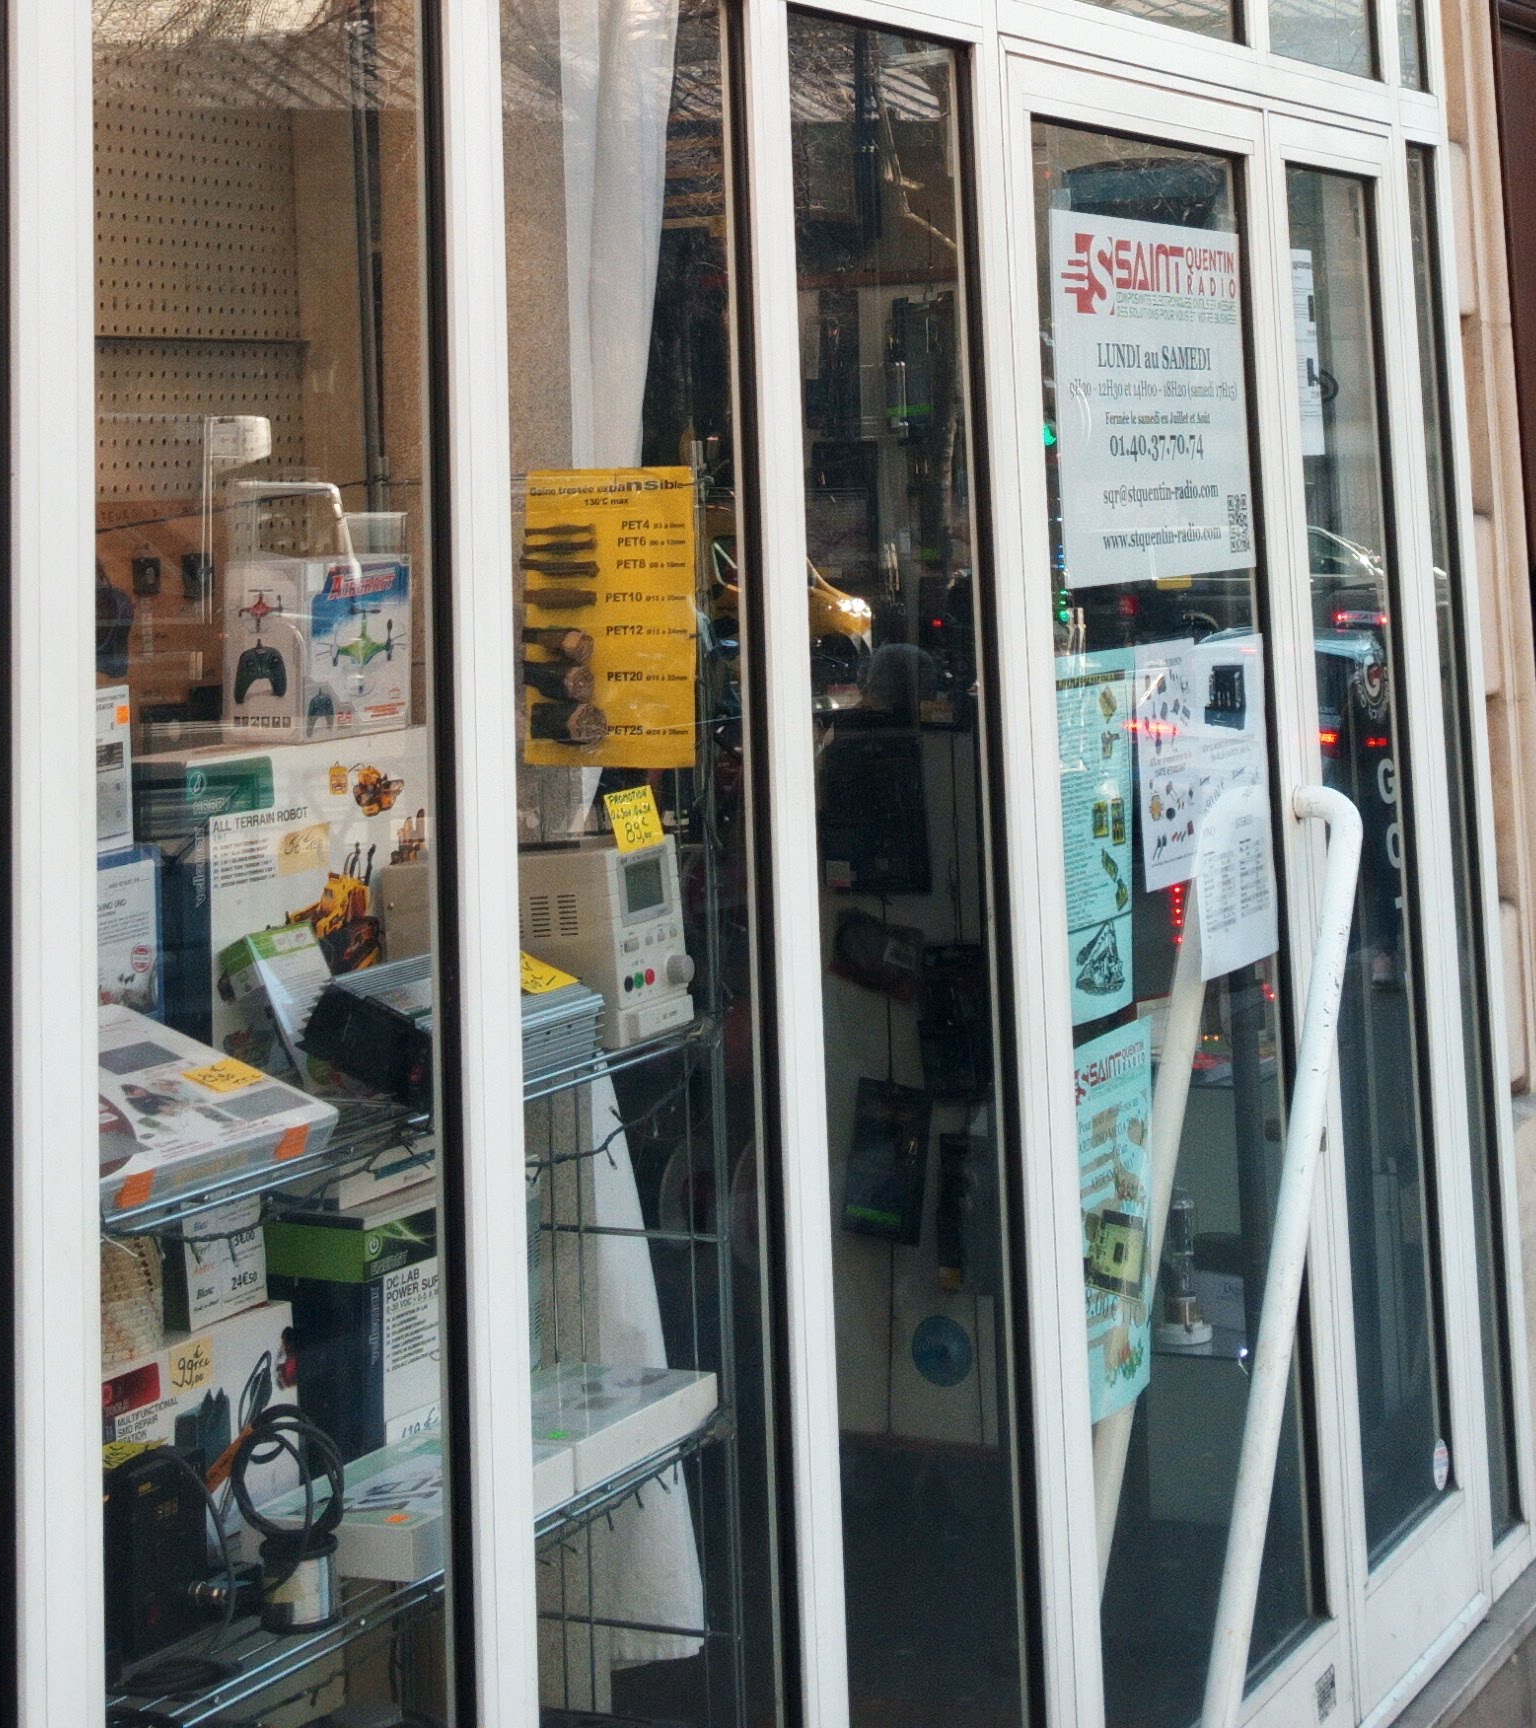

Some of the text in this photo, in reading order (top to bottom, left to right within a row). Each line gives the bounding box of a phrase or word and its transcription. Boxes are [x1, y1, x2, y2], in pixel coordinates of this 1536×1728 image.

[1115, 240, 1185, 294] SAINT
[1185, 246, 1235, 274] QUENTIN
[1186, 275, 1237, 300] RADIO
[1097, 342, 1212, 371] LUNDI au SAMEDI
[1109, 434, 1204, 462] 01.40.37.70.74
[610, 497, 629, 506] max
[1102, 479, 1219, 510] sqr@stquentin-radio.com
[621, 520, 650, 531] PET4
[617, 536, 647, 547] PET6
[1102, 521, 1222, 553] www.stquentin-radio.com
[616, 559, 646, 570] PET8
[605, 592, 643, 603] PET10
[606, 625, 643, 636] PET12
[607, 672, 643, 682] PET20
[607, 725, 643, 736] PET25
[607, 787, 647, 804] PROMOTION
[213, 806, 308, 833] ALL TERRAIN ROBOT
[386, 1268, 420, 1290] DC LAB
[386, 1282, 419, 1304] POWER
[117, 1397, 179, 1427] MULTIFUNCTIONAL
[134, 1414, 158, 1432] REPAIR
